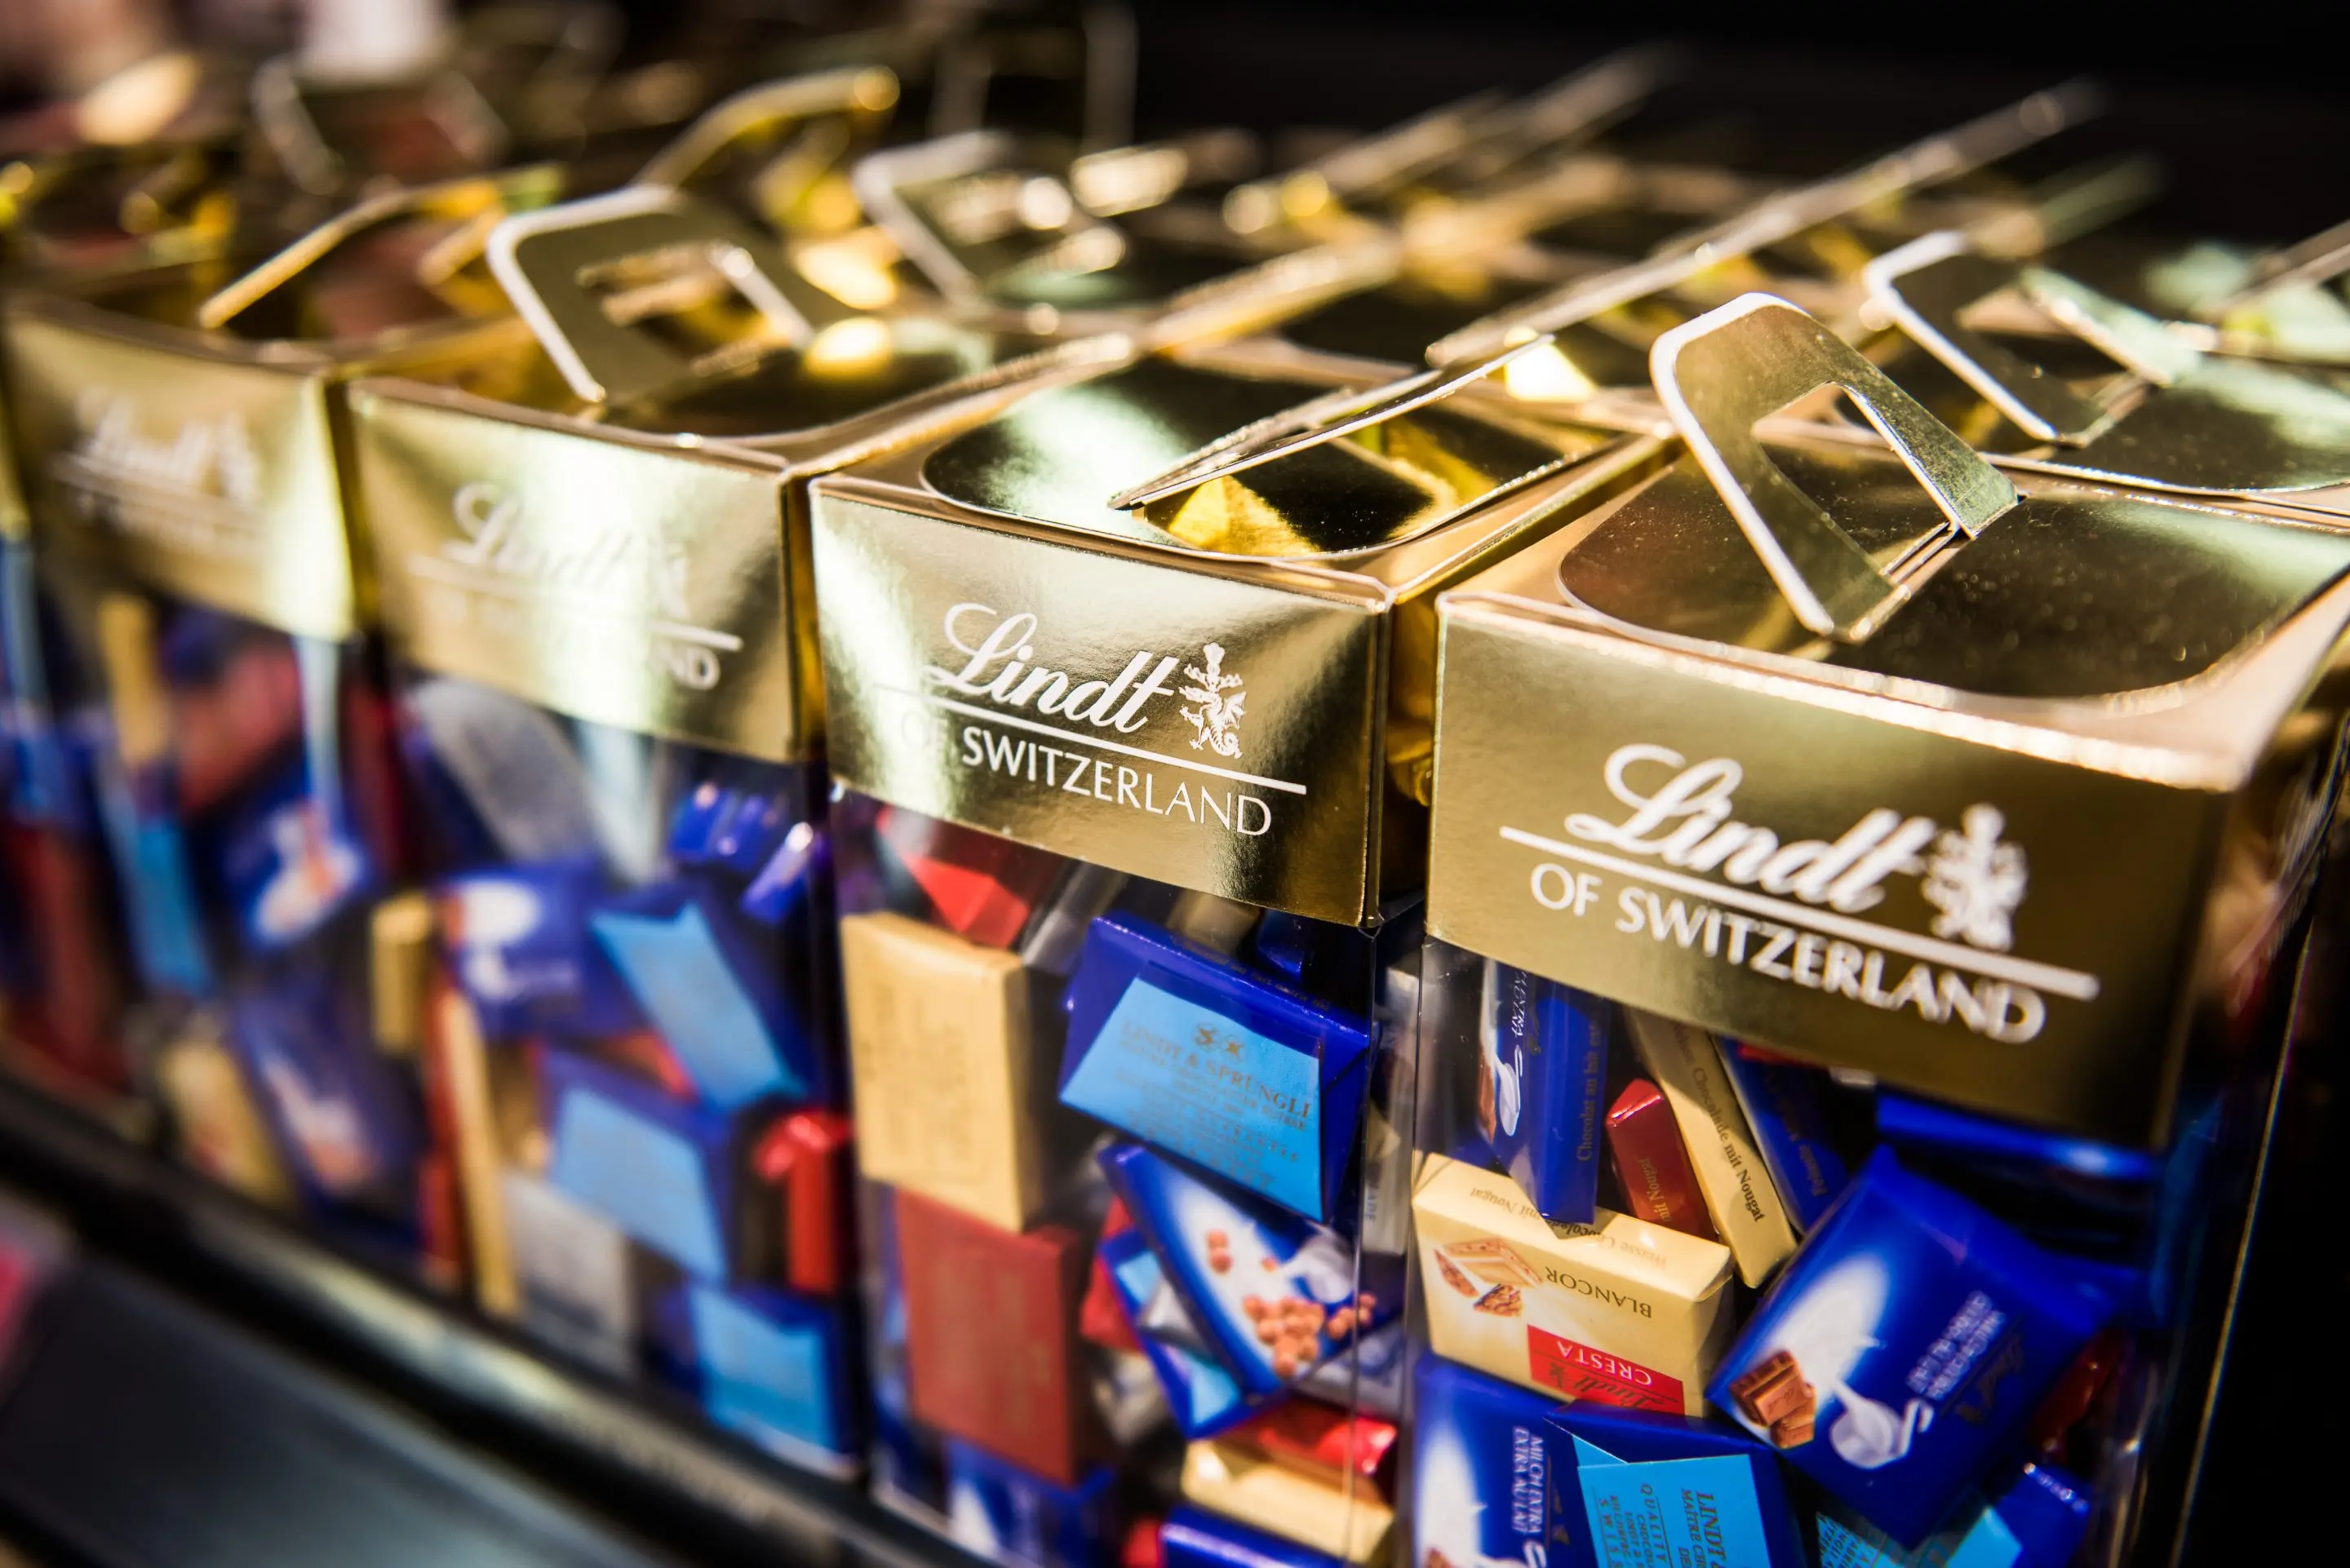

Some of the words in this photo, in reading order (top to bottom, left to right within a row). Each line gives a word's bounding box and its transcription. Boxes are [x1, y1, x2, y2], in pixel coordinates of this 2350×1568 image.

[923, 602, 1180, 733] Lindt
[961, 726, 1272, 836] SWITZERLAND
[1564, 742, 1940, 915] Lindt
[1530, 862, 1603, 917] OF
[1616, 885, 2047, 1044] SWITZERLAND
[1638, 1157, 1665, 1203] Nougat
[1692, 1066, 1730, 1143] Chocolade
[1723, 1143, 1744, 1168] mit
[1736, 1168, 1766, 1222] Nougat
[1470, 1187, 1518, 1216] Nougat
[1545, 1266, 1652, 1318] BLANCOR
[1557, 1340, 1653, 1386] CRESTA
[1639, 1482, 1667, 1563] QUALITY
[1695, 1490, 1727, 1561] LINDT
